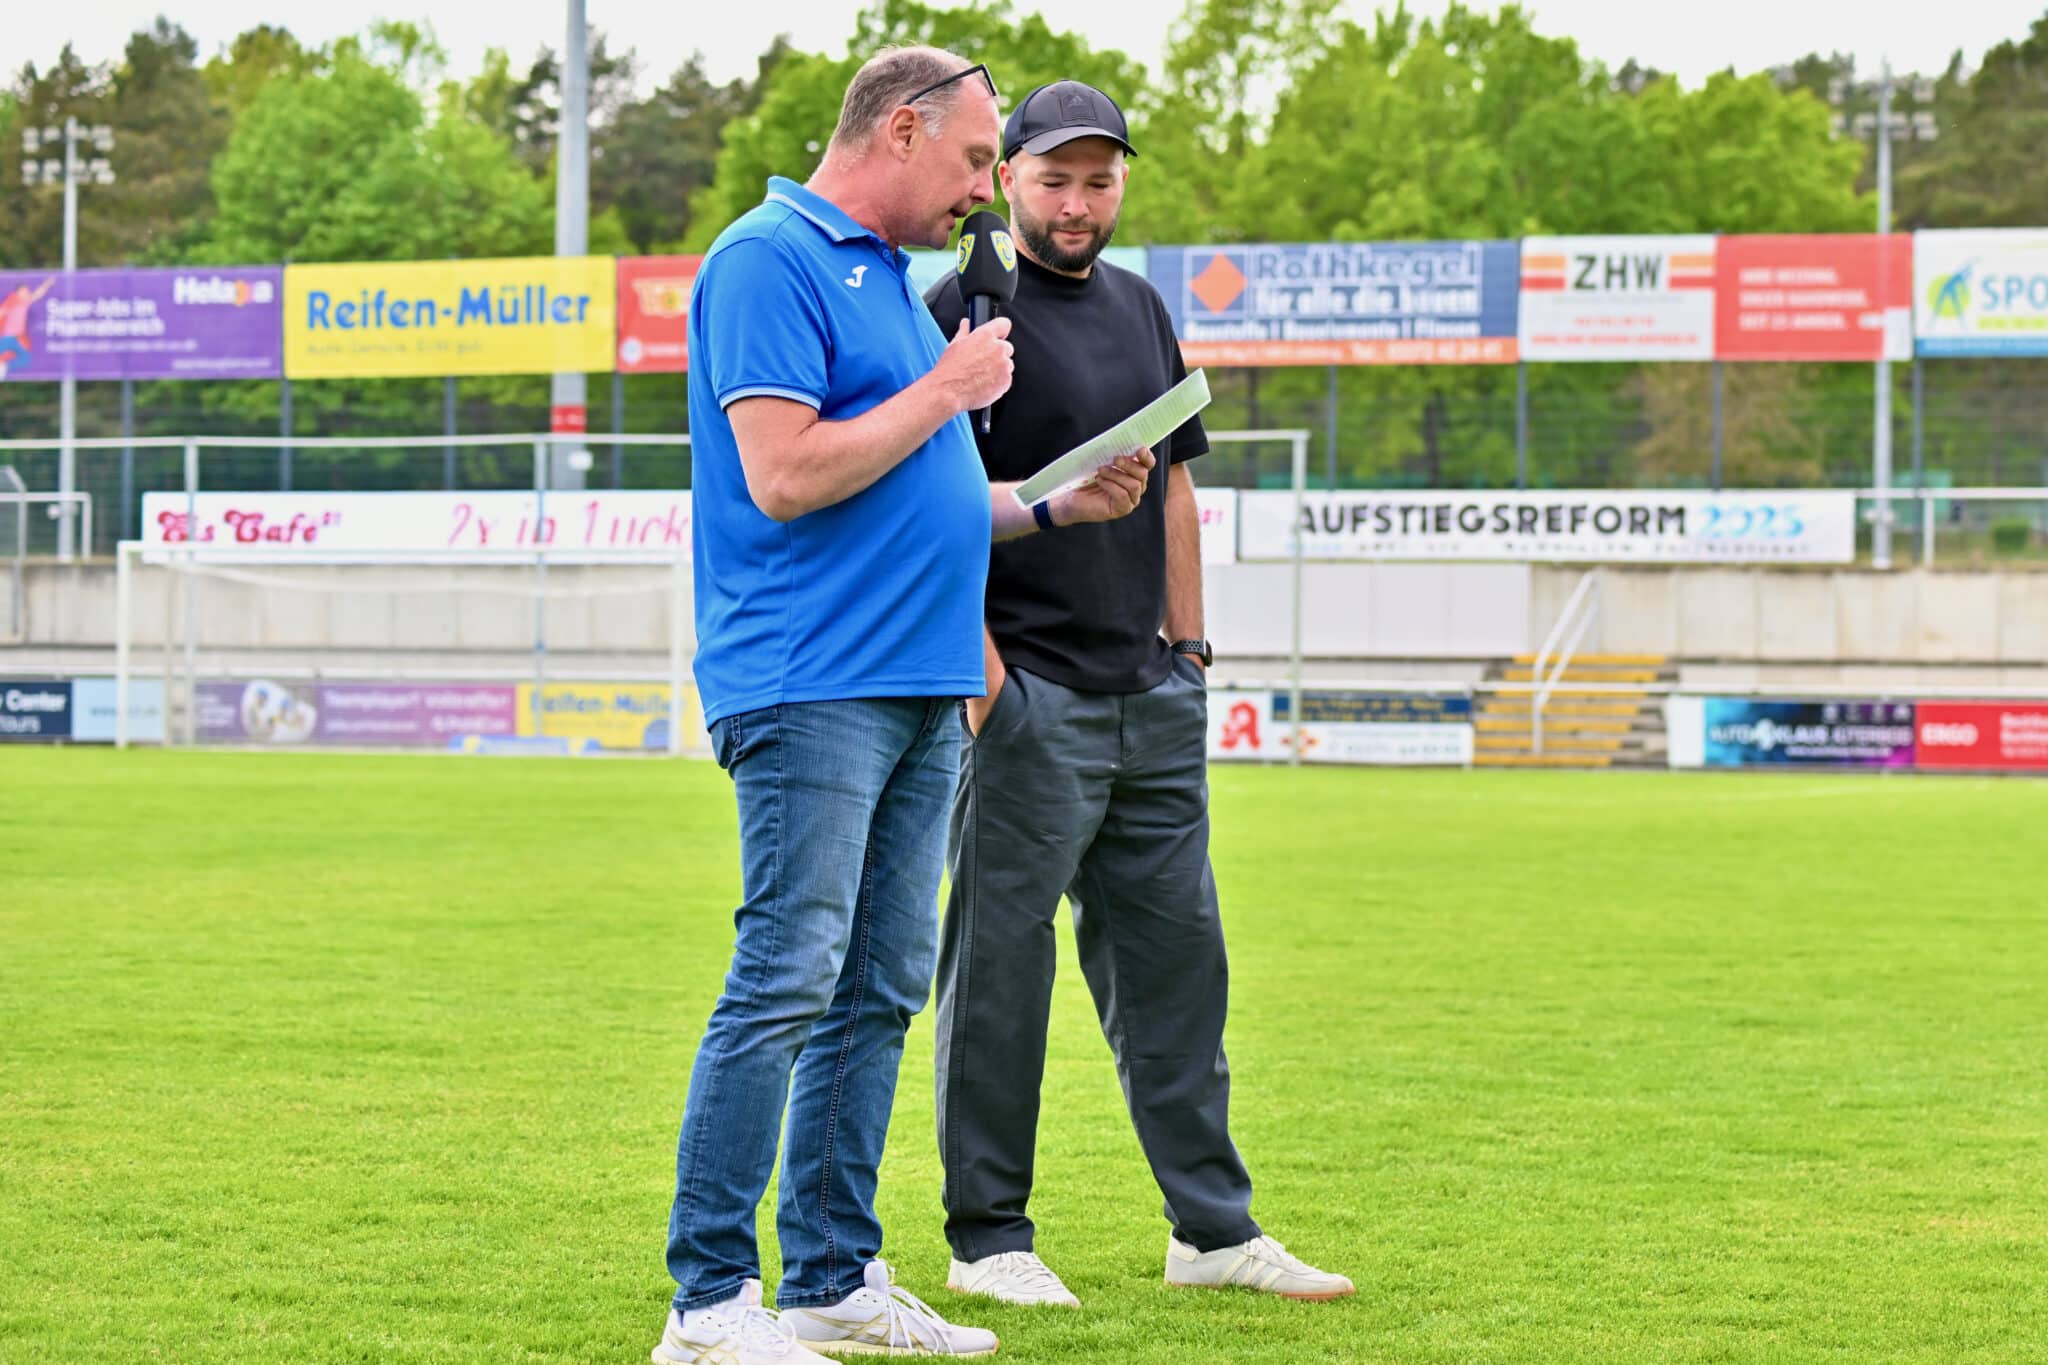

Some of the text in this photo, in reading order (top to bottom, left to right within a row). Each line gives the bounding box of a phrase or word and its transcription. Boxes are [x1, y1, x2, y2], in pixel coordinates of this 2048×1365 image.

[1256, 246, 1479, 286] Rothkegel
[1574, 255, 1662, 290] ZHW
[306, 284, 591, 330] Reifen-Müller
[1292, 504, 1805, 538] AUFSTIEGSREFORM 2025
[1920, 723, 1979, 746] ERGO
